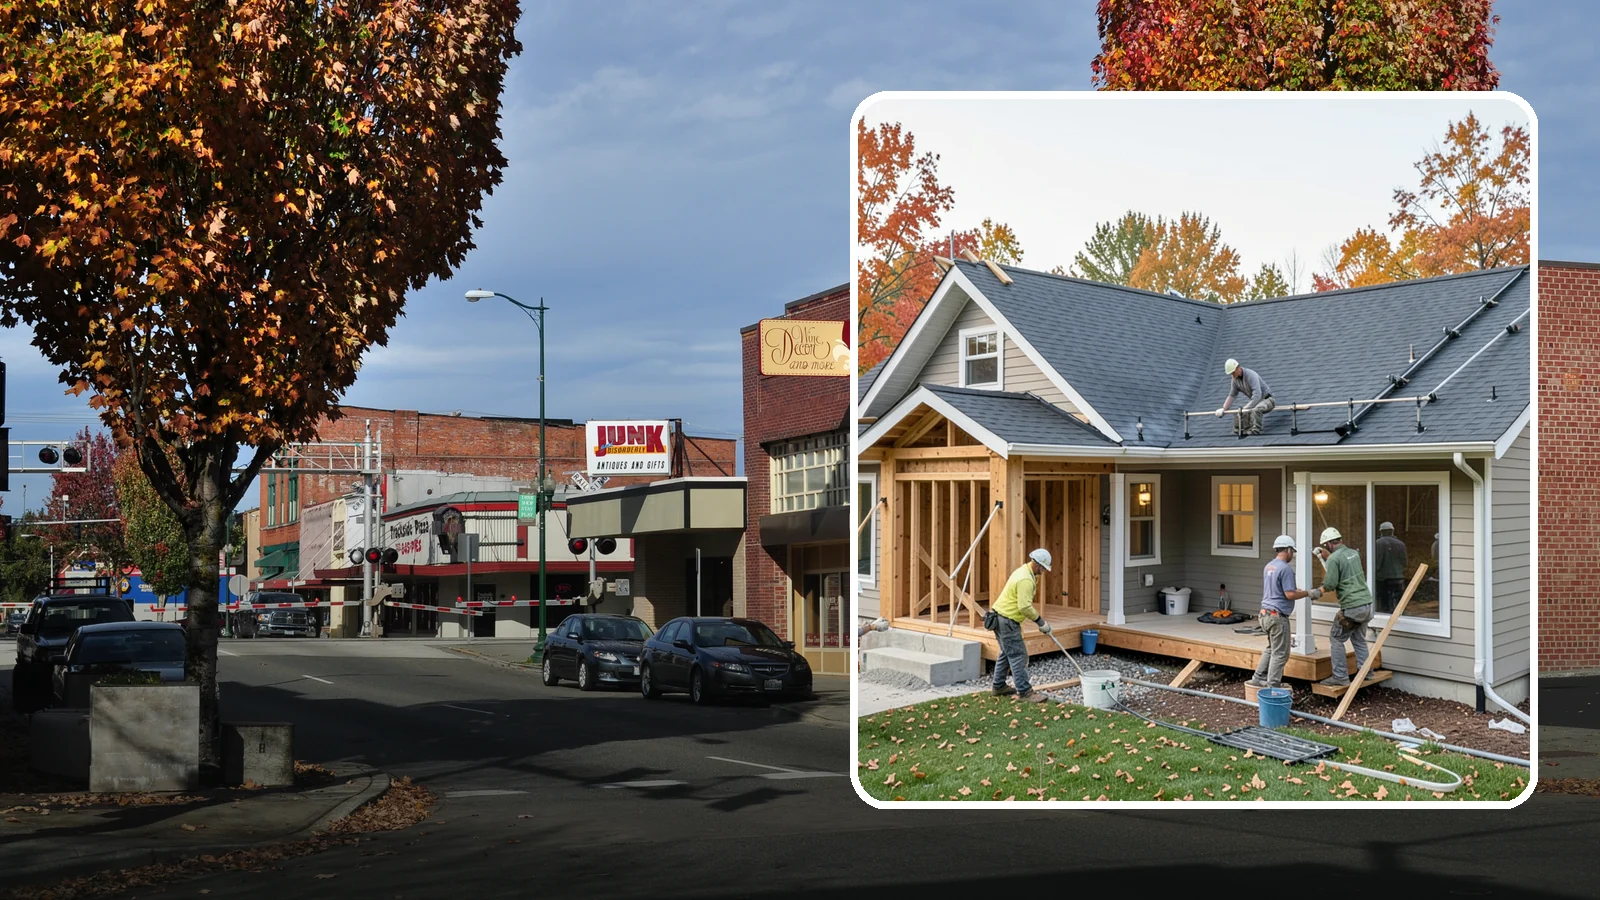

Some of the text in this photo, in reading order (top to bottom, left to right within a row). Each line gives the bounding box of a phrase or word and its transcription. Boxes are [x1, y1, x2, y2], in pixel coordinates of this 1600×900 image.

[595, 425, 665, 457] JUNK
[607, 446, 645, 454] DISORDERLY
[597, 460, 665, 470] ANTIQUES AND GIFTS
[414, 519, 429, 534] Pizza
